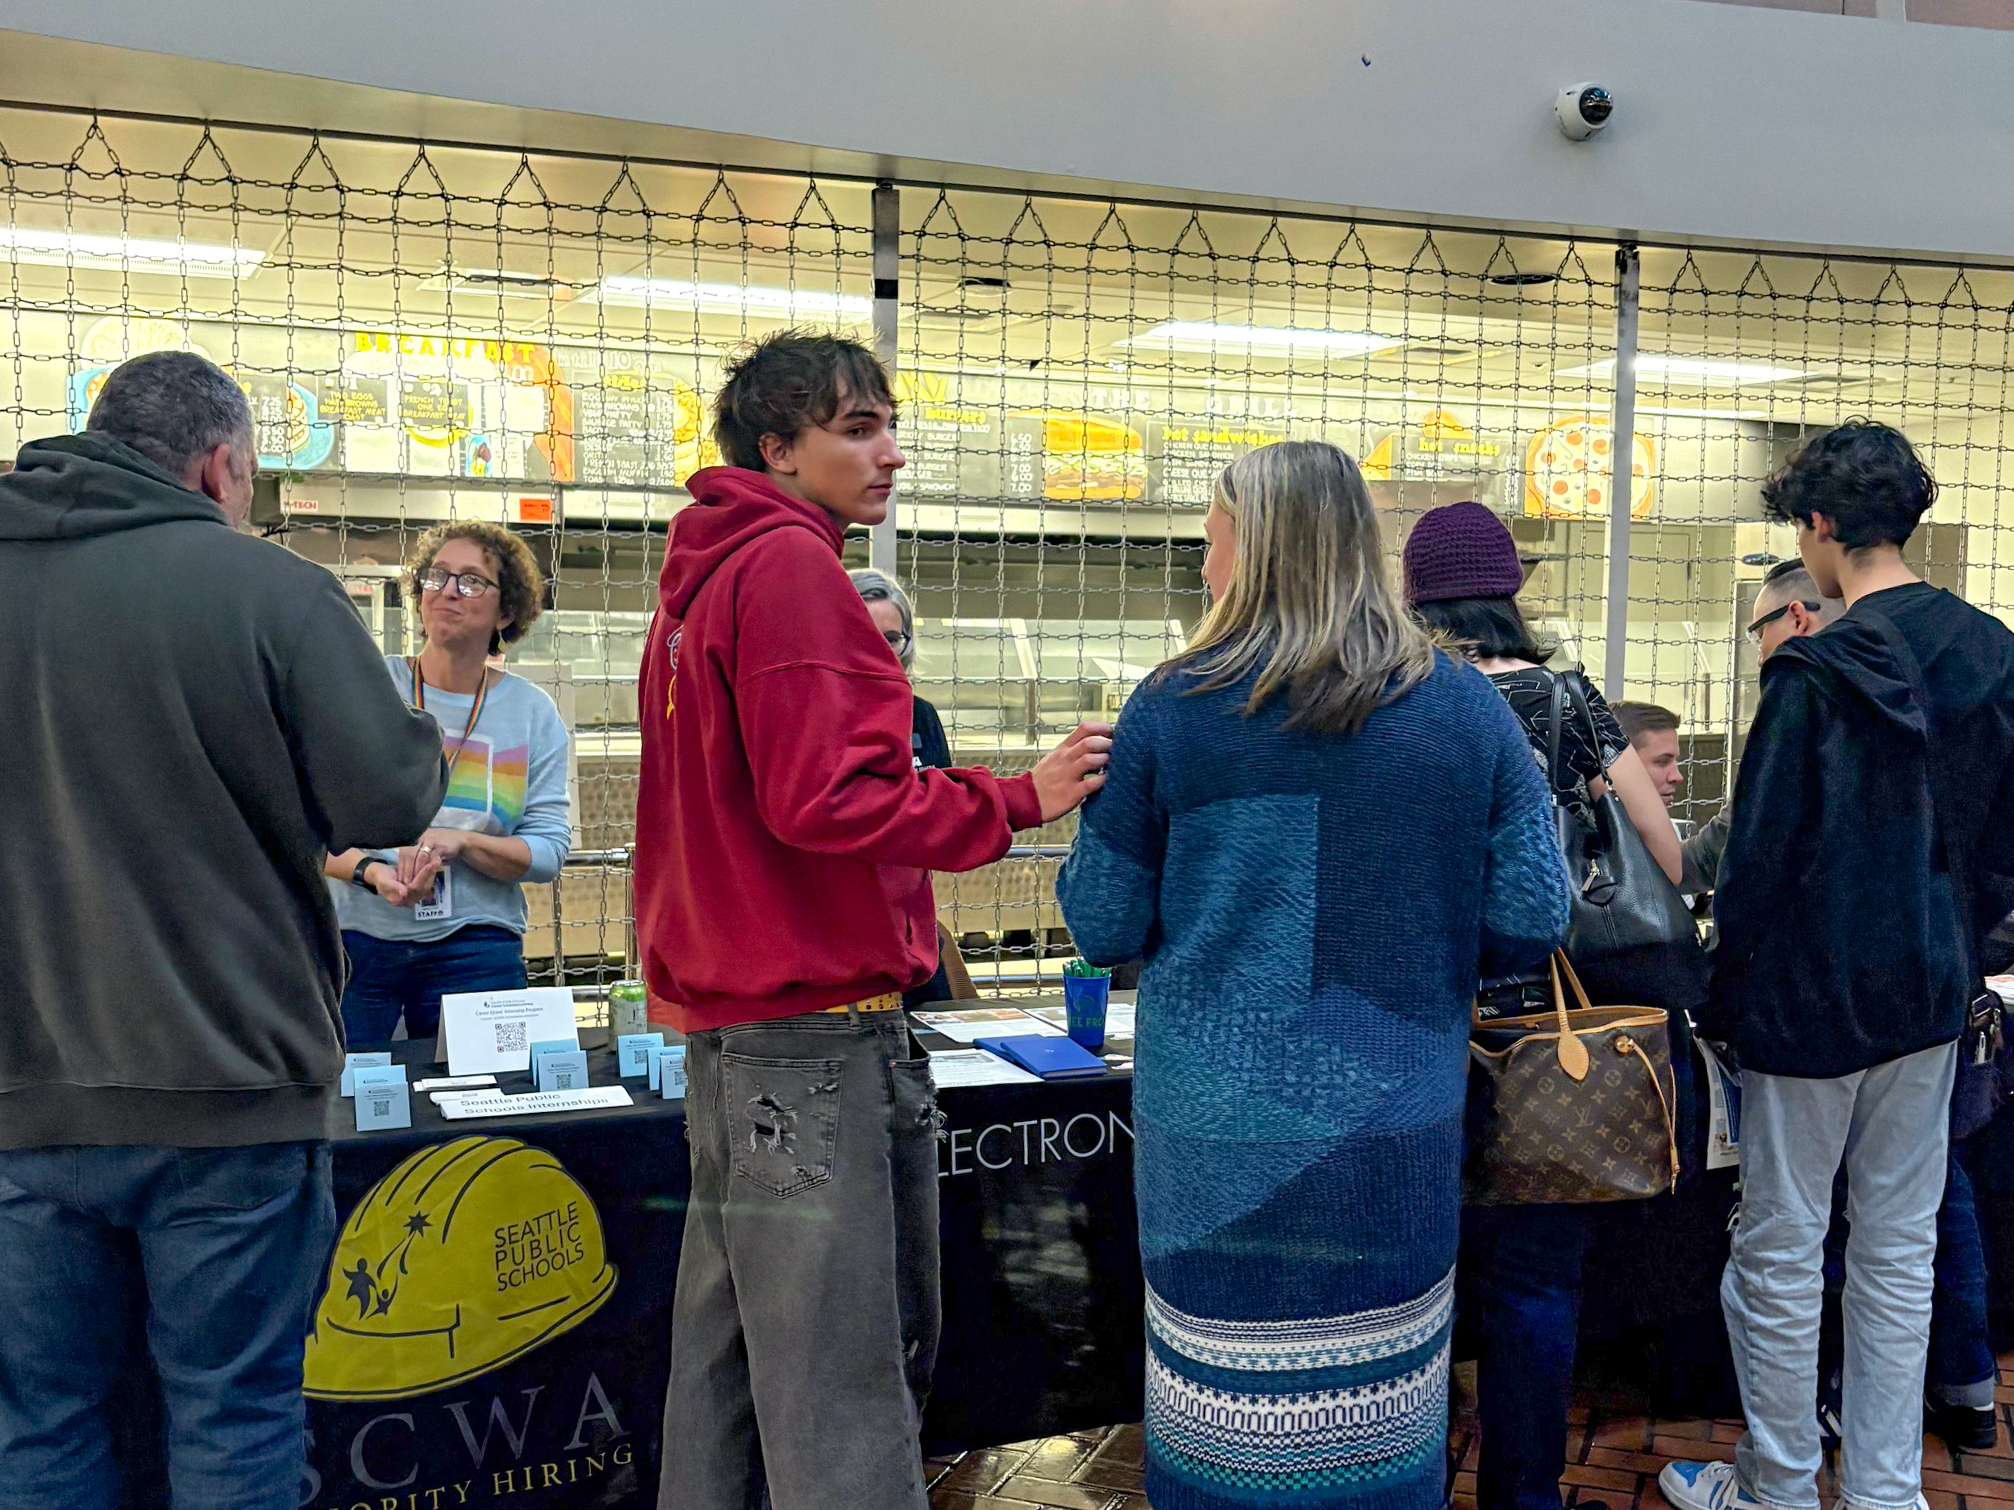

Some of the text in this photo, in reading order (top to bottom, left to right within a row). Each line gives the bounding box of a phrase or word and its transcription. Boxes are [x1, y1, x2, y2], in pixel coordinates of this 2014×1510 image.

[355, 332, 536, 364] BREAKFAST
[608, 351, 632, 370] 10
[438, 397, 463, 406] TOST
[1090, 390, 1150, 409] THE
[1206, 394, 1299, 418] GRILL
[582, 417, 617, 427] SAUSGE
[1161, 426, 1190, 442] hot
[1163, 442, 1193, 450] CICKEN
[1418, 437, 1443, 452] hot
[1163, 450, 1196, 458] CICKEN
[460, 1093, 561, 1107] Seattle Public
[464, 1097, 610, 1114] Schools Internships
[494, 1200, 579, 1248] SEATTLE
[495, 1221, 581, 1272] PUBLIC
[497, 1242, 584, 1292] SCHOOLS
[493, 1443, 634, 1497] HIRING
